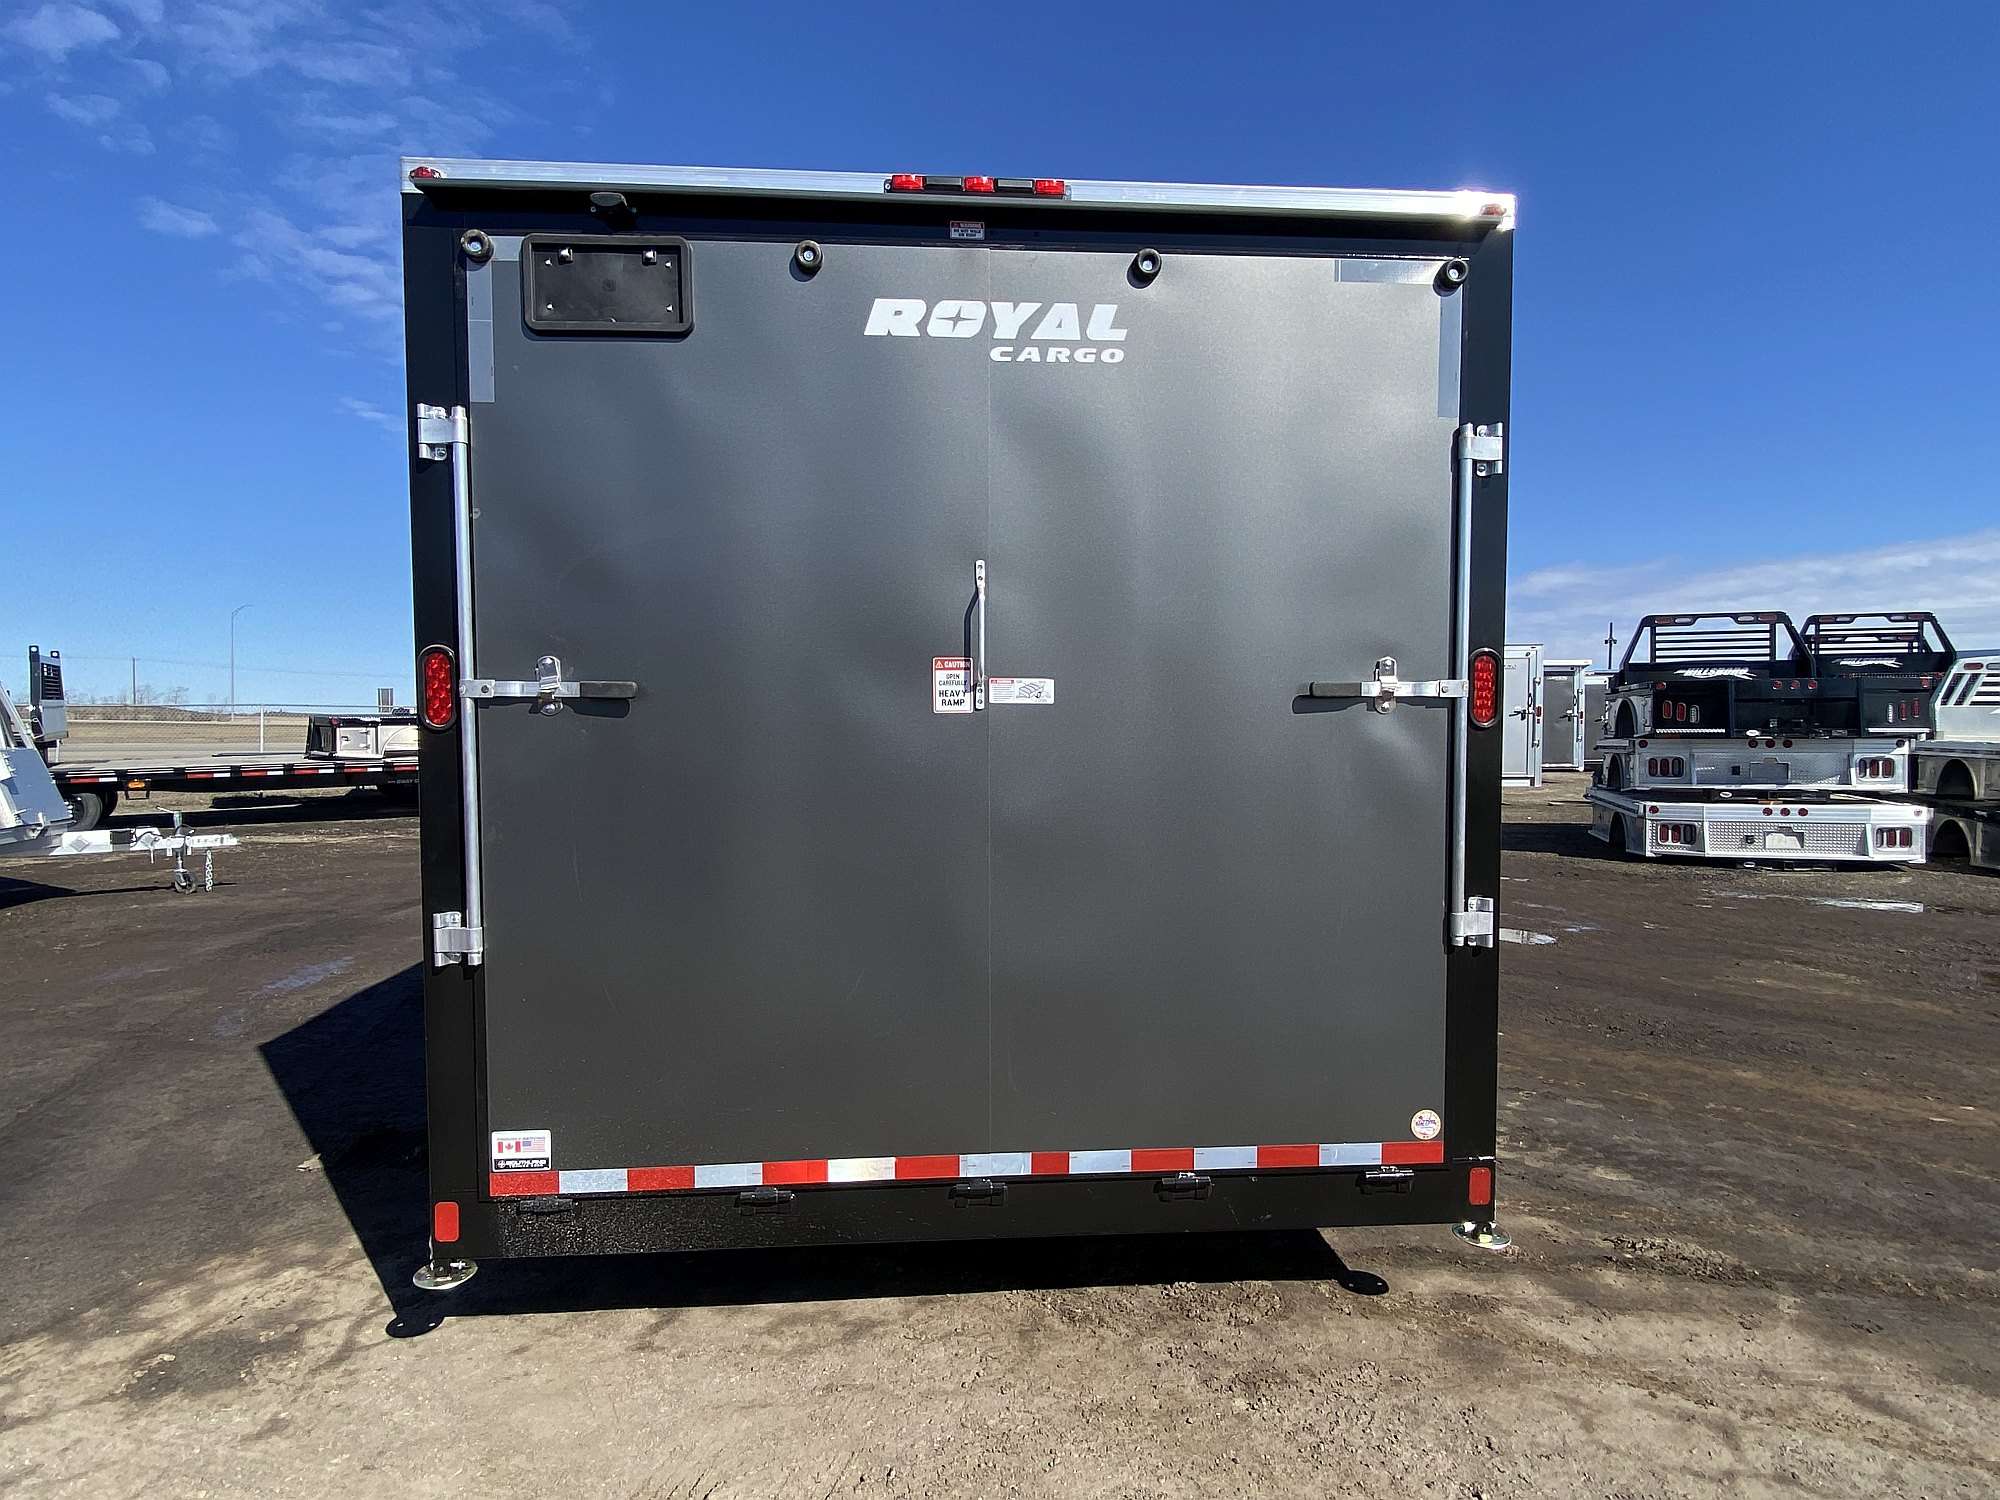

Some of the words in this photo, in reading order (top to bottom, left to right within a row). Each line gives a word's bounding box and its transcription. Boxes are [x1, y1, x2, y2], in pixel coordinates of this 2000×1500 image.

[863, 298, 1128, 341] ROYAL
[989, 346, 1125, 364] CARGO
[944, 660, 970, 668] CAUTION
